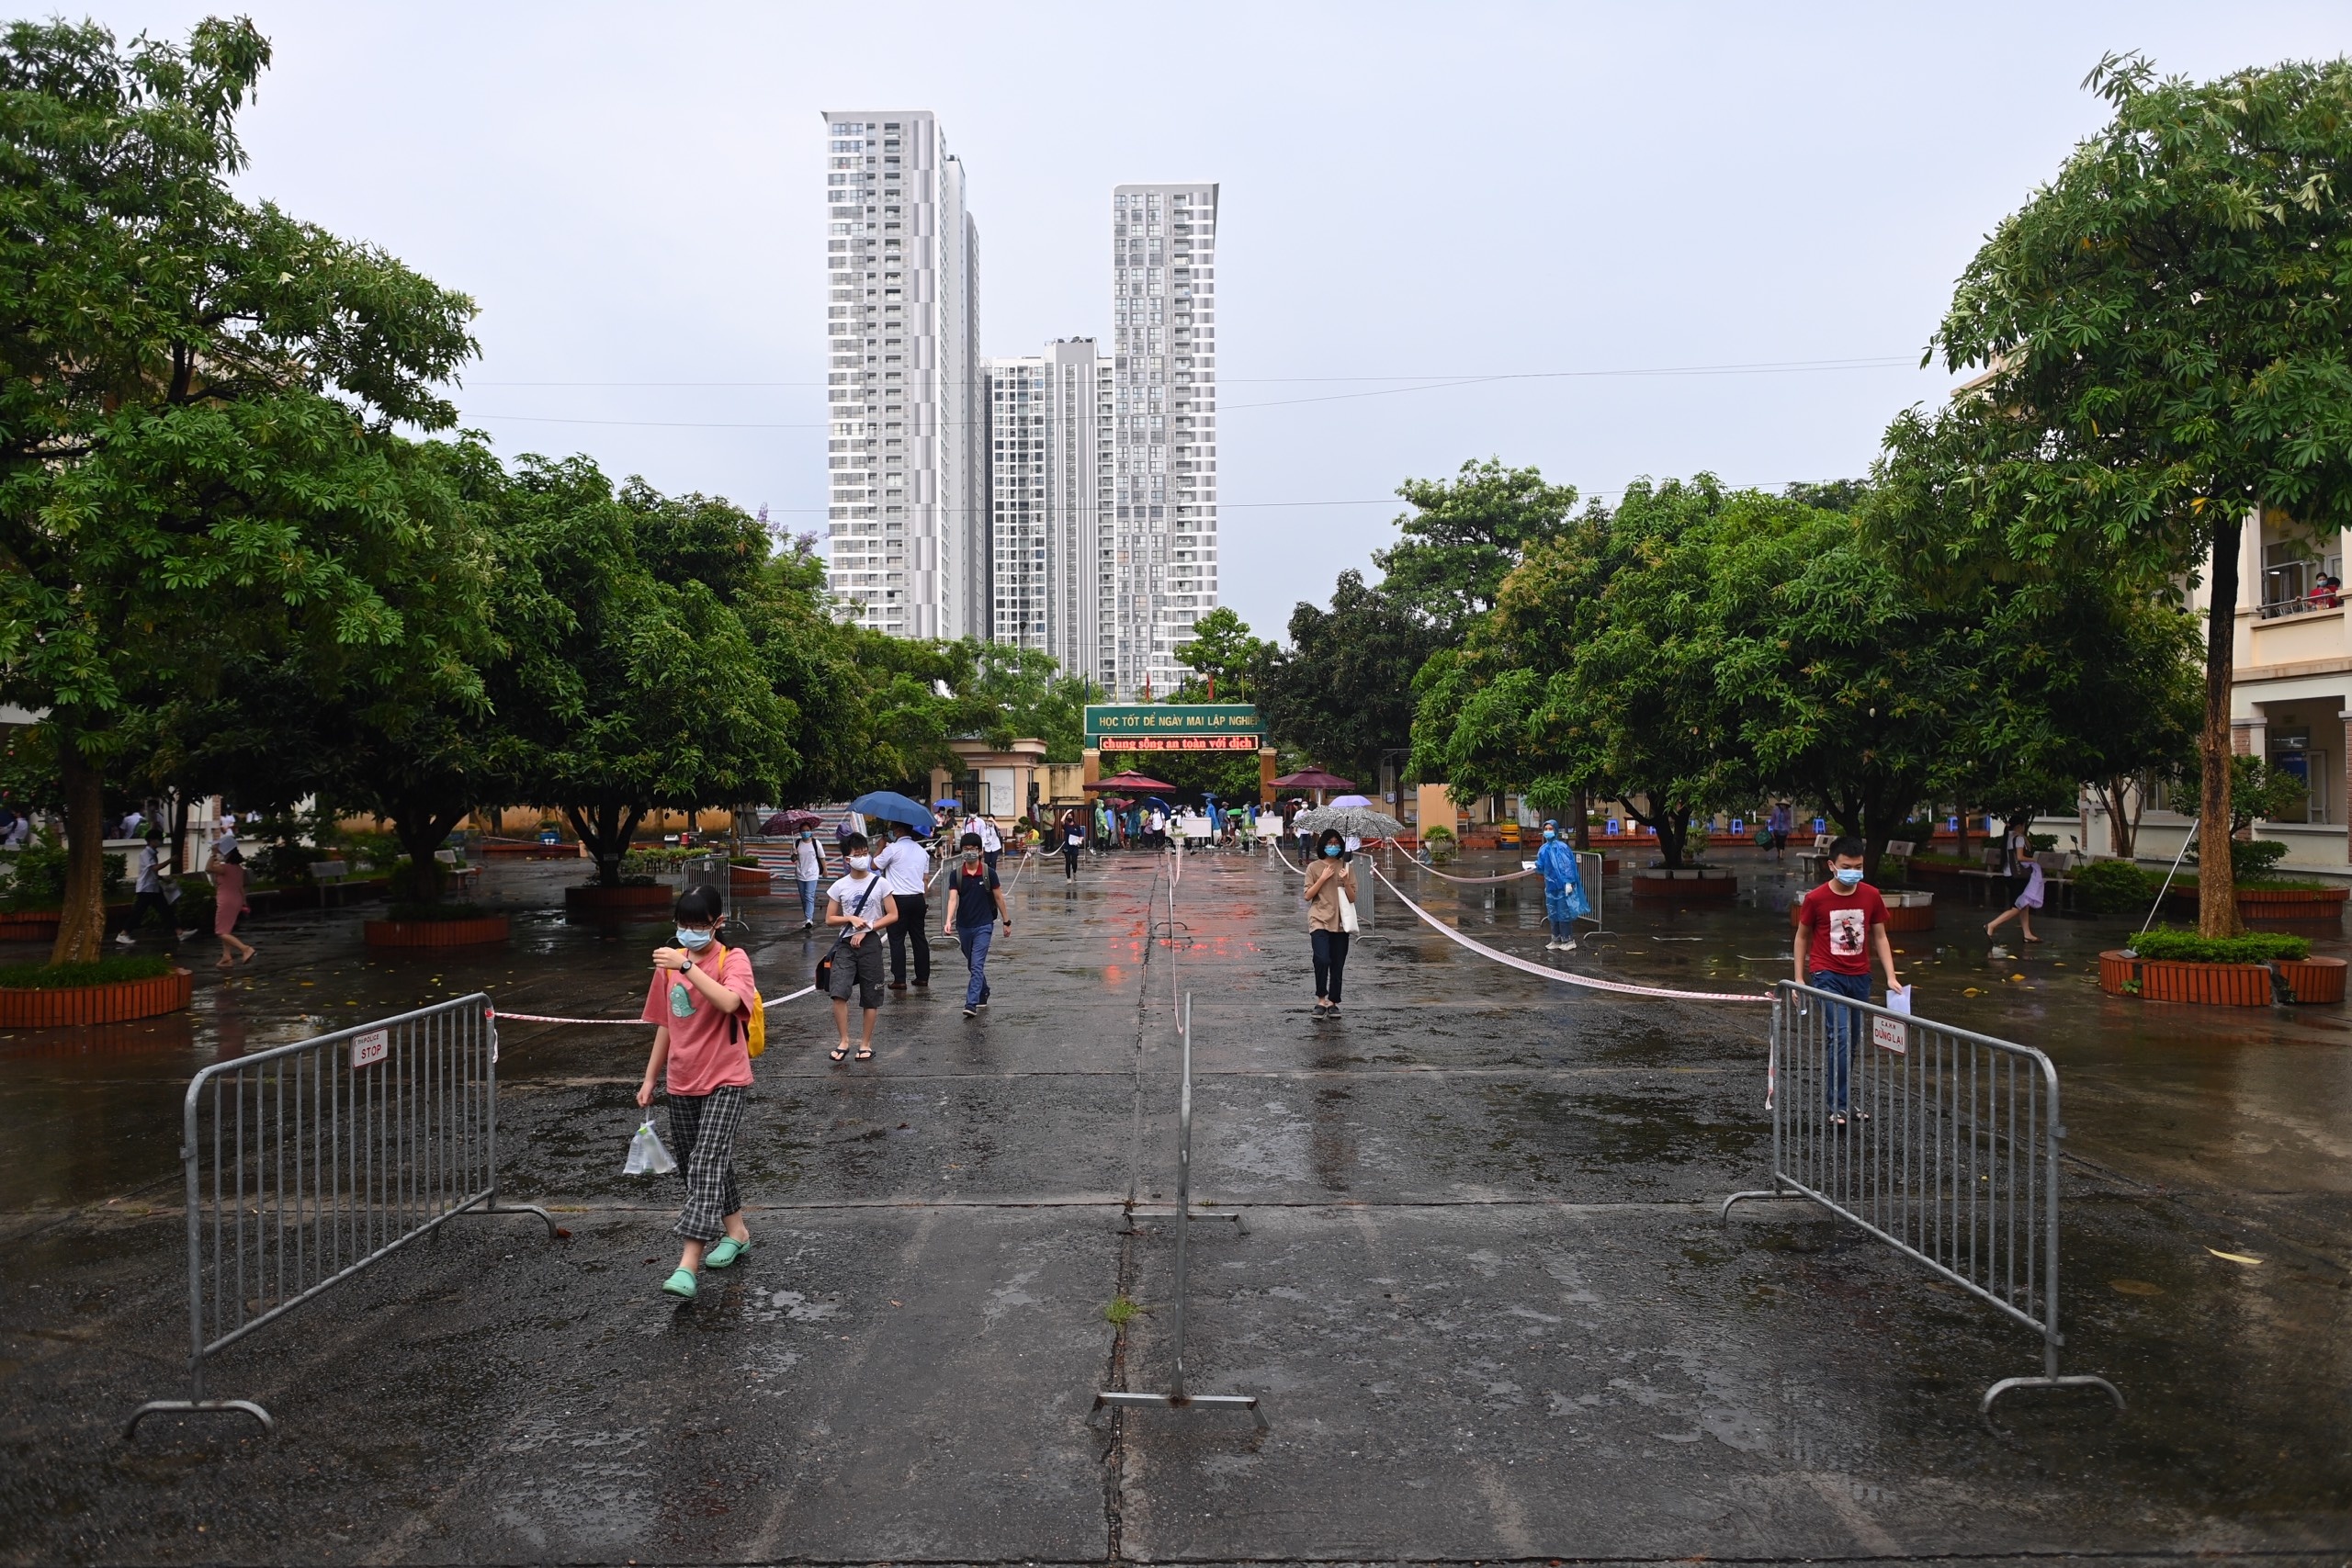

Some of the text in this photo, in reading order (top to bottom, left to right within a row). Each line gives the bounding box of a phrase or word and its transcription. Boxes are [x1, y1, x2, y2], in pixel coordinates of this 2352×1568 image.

[1099, 716, 1119, 729] HỌC
[1122, 713, 1139, 727] TỐT
[1143, 711, 1156, 727] ĐỂ
[1159, 714, 1182, 727] NGÀY
[1186, 716, 1204, 726] MAI
[1207, 714, 1226, 728] LẬP
[1102, 738, 1136, 750] chung
[1166, 740, 1180, 749] an
[1182, 738, 1206, 749] toàn
[1209, 738, 1227, 749] với
[1228, 737, 1252, 750] dịch
[361, 1043, 382, 1059] STOP
